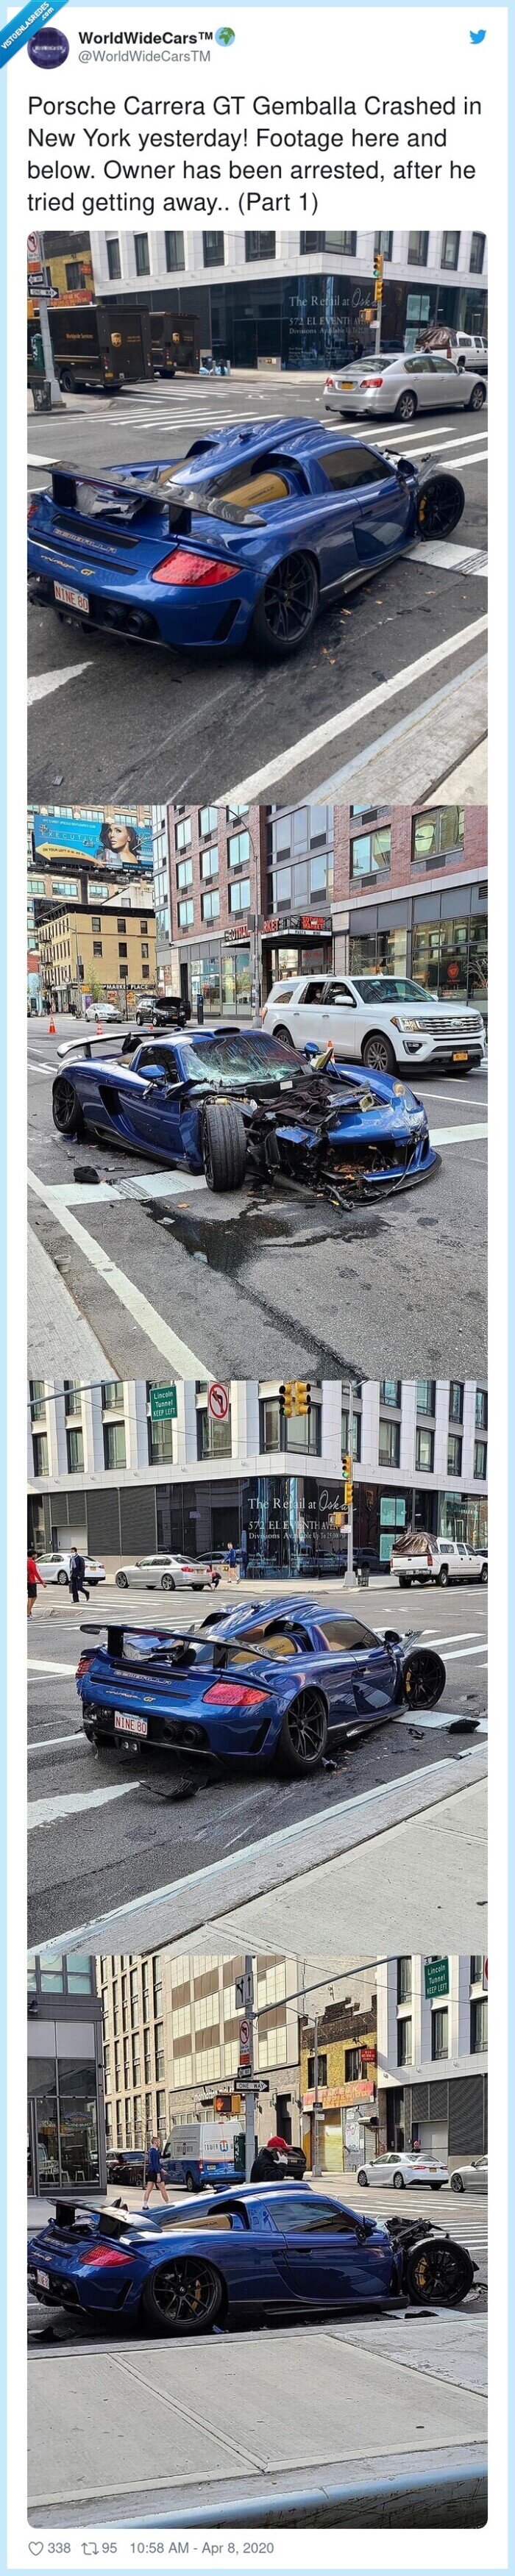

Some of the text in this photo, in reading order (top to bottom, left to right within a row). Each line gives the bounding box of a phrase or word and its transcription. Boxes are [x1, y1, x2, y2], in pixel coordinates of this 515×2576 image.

[289, 296, 308, 307] The
[311, 296, 340, 306] Retail
[352, 287, 386, 307] Oska
[54, 586, 88, 611] NINE 80
[41, 831, 100, 842] EXECUTIVE
[154, 1391, 173, 1400] Lincoln
[155, 1400, 173, 1408] Tunnel
[153, 1409, 164, 1417] KEEP
[248, 1489, 357, 1511] The Retail at Oska
[248, 1521, 265, 1530] 572
[313, 1532, 319, 1540] Up
[116, 1716, 135, 1731] NINE
[137, 1721, 146, 1734] 80
[427, 1964, 446, 1975] Lincoln
[429, 1974, 446, 1984] Tunnel
[427, 1983, 447, 1994] KEEP LEFT
